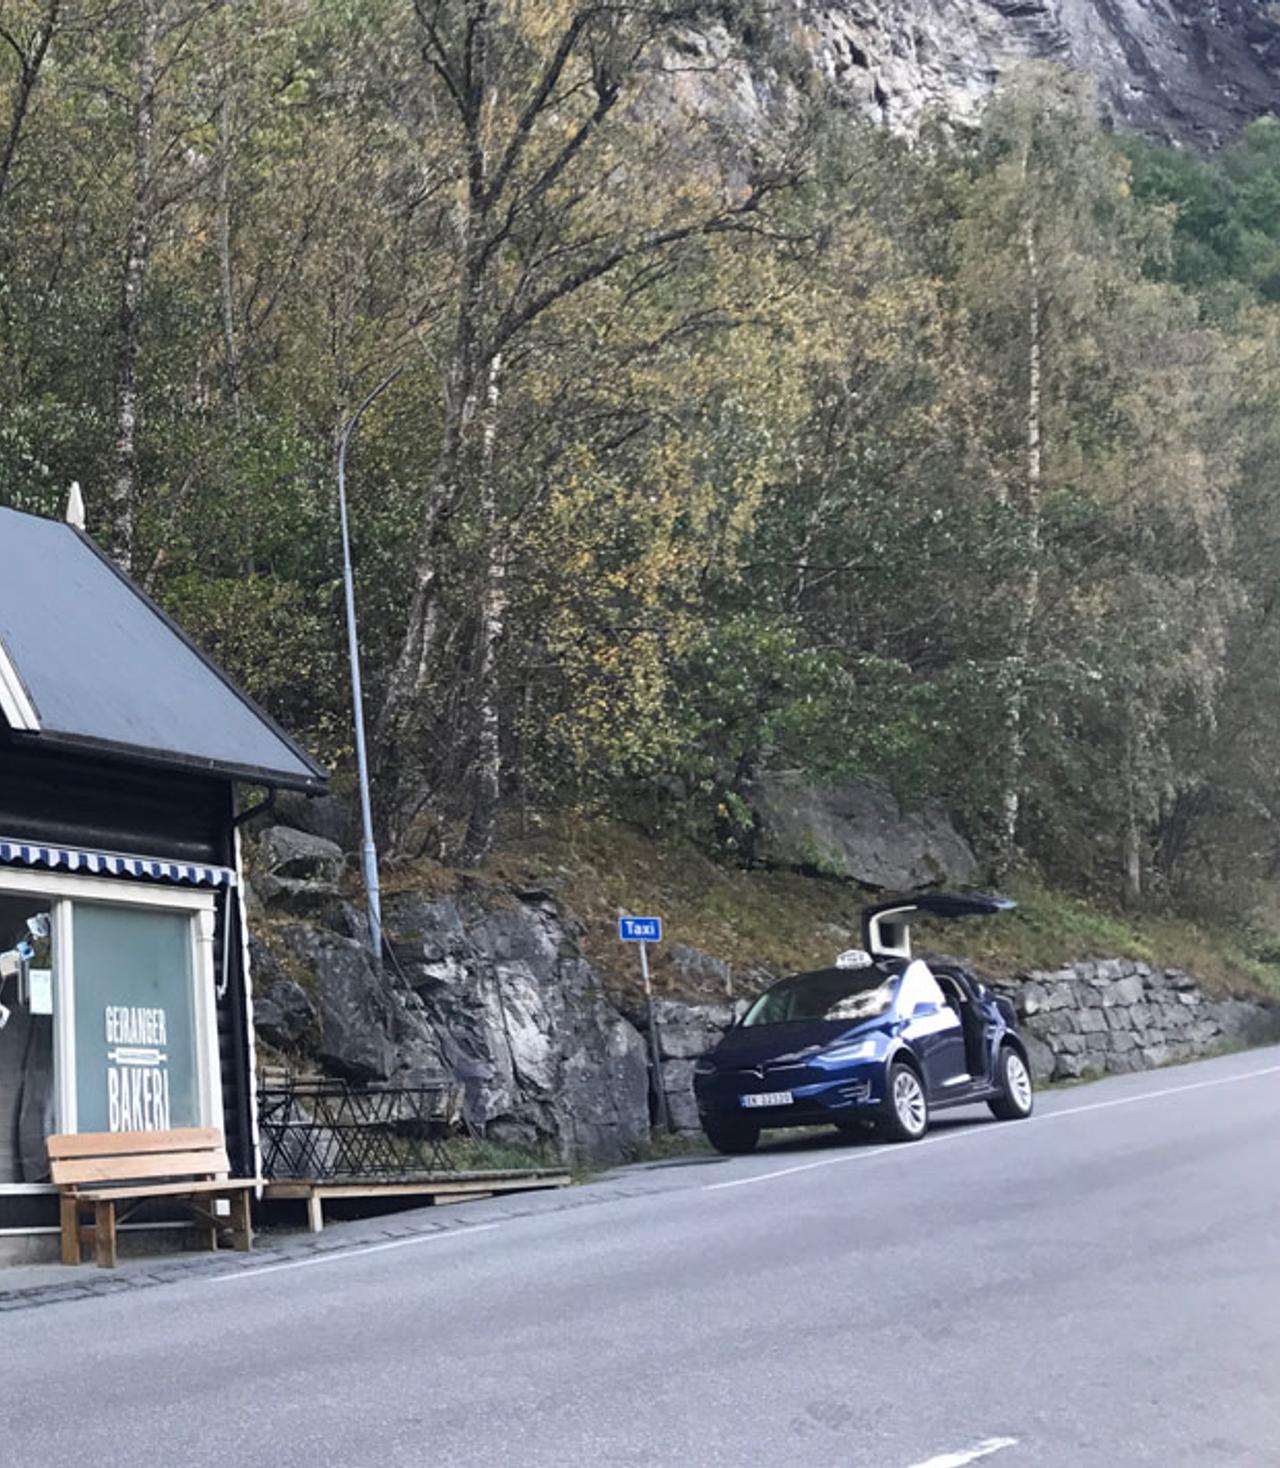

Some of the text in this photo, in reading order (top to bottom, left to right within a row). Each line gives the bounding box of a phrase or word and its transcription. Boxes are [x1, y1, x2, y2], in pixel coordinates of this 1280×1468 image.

[624, 920, 656, 935] Taxi
[105, 1005, 166, 1045] GEIRANGER
[107, 1067, 170, 1132] BAKERI
